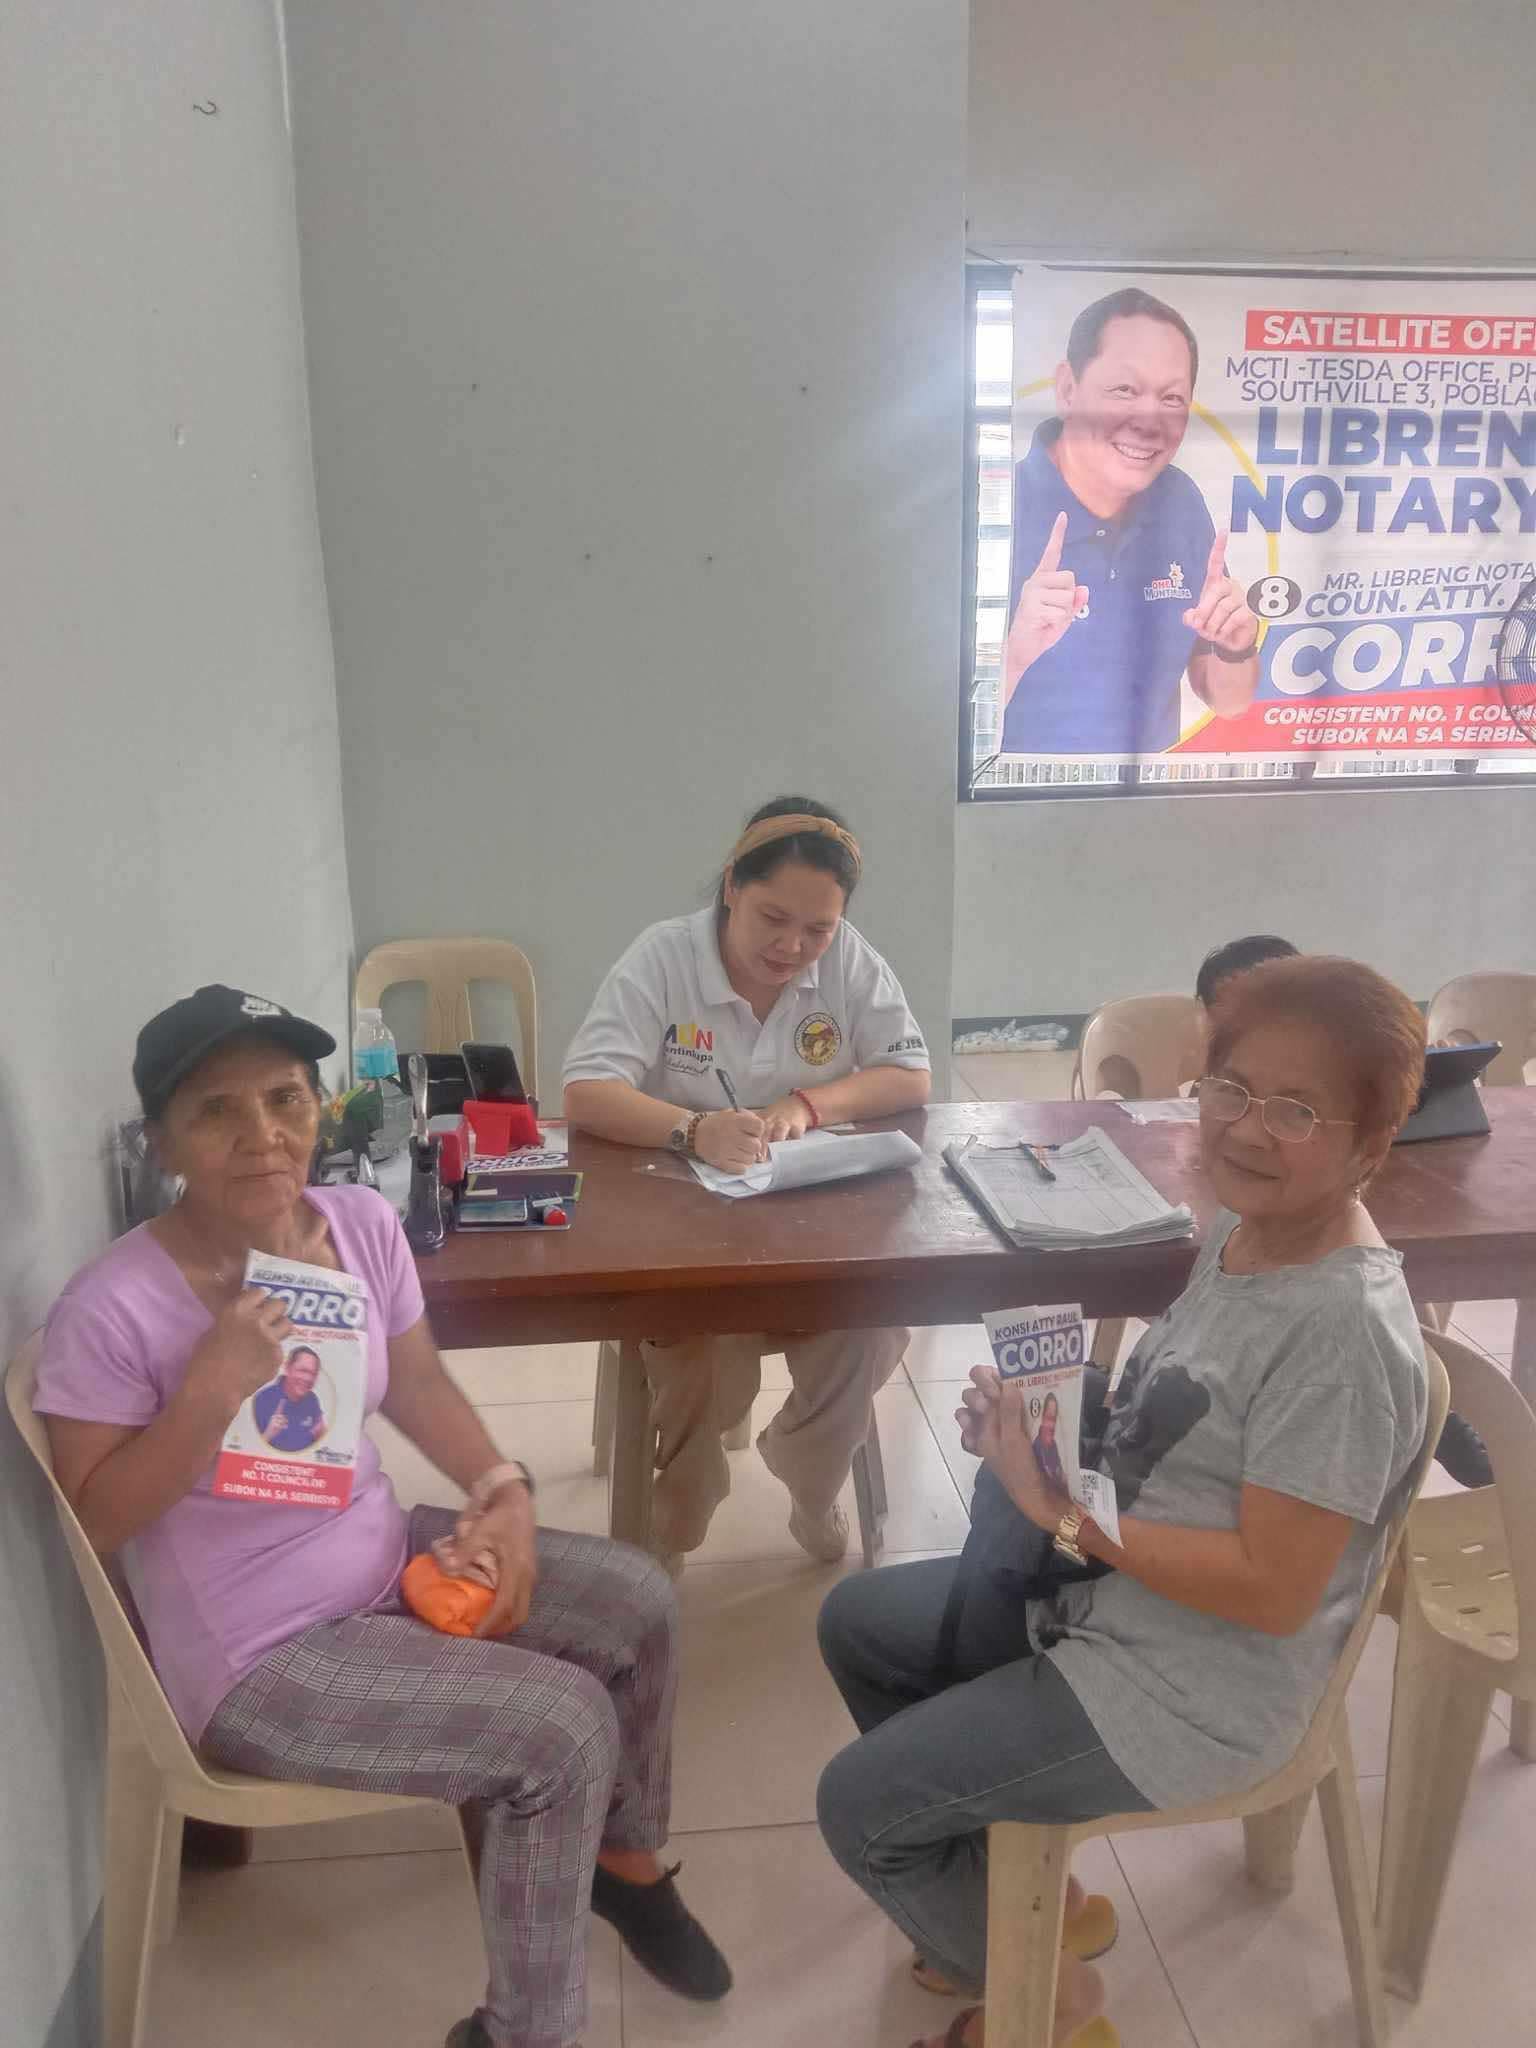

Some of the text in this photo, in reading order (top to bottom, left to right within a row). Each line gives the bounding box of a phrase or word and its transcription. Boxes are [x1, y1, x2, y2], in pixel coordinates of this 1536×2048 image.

[1262, 315, 1536, 350] SATELLITE OFF
[1226, 356, 1289, 380] MCTI
[1402, 360, 1500, 384] OFFICE,
[1240, 380, 1536, 408] SOUTHVILLE 3, POBLA
[1256, 406, 1536, 467] LIBREN
[1230, 475, 1536, 534] NOTARY
[1324, 572, 1364, 591] MR.
[1371, 565, 1469, 589] LIBRENG
[1259, 576, 1290, 617] 8
[1304, 588, 1408, 617] COUN.
[1416, 583, 1505, 612] ATTY.
[1263, 706, 1403, 725] CONSISTENT
[1407, 705, 1448, 724] NO.
[1454, 705, 1464, 722] 1
[1290, 727, 1369, 745] SUBOK
[1375, 727, 1408, 744] NA
[1414, 727, 1444, 744] SA
[1000, 1328, 1081, 1374] CORRO
[1031, 1397, 1041, 1418] 8
